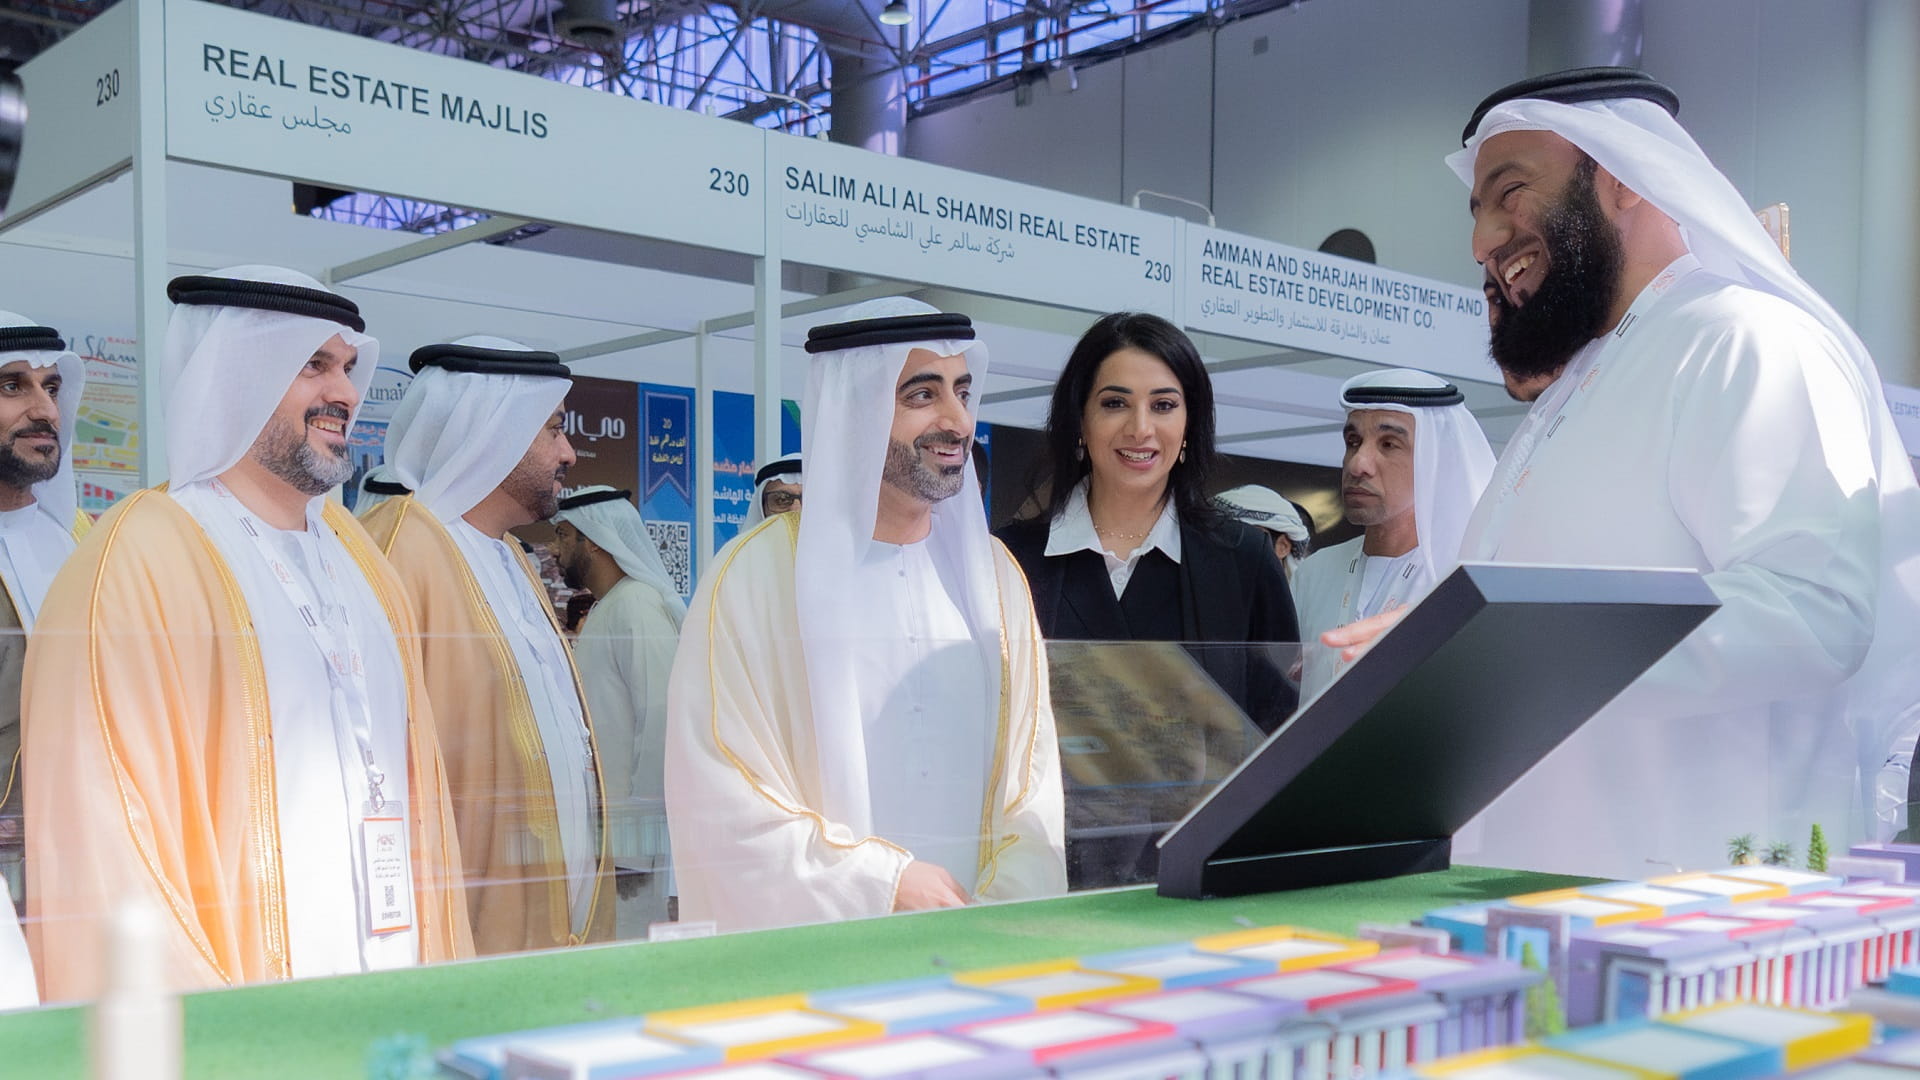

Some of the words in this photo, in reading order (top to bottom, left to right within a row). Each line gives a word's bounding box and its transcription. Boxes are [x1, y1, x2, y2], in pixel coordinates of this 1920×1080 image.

[96, 68, 120, 107] 230
[203, 43, 297, 89] REAL
[309, 65, 429, 115] ESTATE
[441, 93, 548, 139] MAJLIS
[205, 90, 273, 123] عقاري
[282, 105, 352, 138] مجلس
[710, 167, 749, 197] 230
[785, 166, 856, 201] SALIM
[862, 181, 896, 209] ALI
[902, 190, 930, 216] AL
[936, 196, 1013, 232] SHAMSI
[1020, 212, 1069, 243] REAL
[1075, 223, 1141, 257] ESTATE
[786, 202, 849, 228] للعقارات
[856, 217, 914, 243] الشامسي
[919, 225, 943, 254] علي
[948, 231, 981, 252] سالم
[986, 236, 1015, 263] شركة
[1145, 259, 1172, 284] 230
[1203, 239, 1262, 269] AMMAN
[1266, 252, 1298, 276] AND
[1302, 260, 1368, 293] SHARJAH
[1371, 276, 1454, 311] INVESTMENT
[1456, 296, 1483, 317] AND
[1201, 296, 1240, 318] العقاري
[1202, 263, 1244, 290] REAL
[1248, 273, 1304, 303] ESTATE
[1308, 286, 1410, 324] DEVELOPMENT
[1413, 309, 1436, 331] CO.
